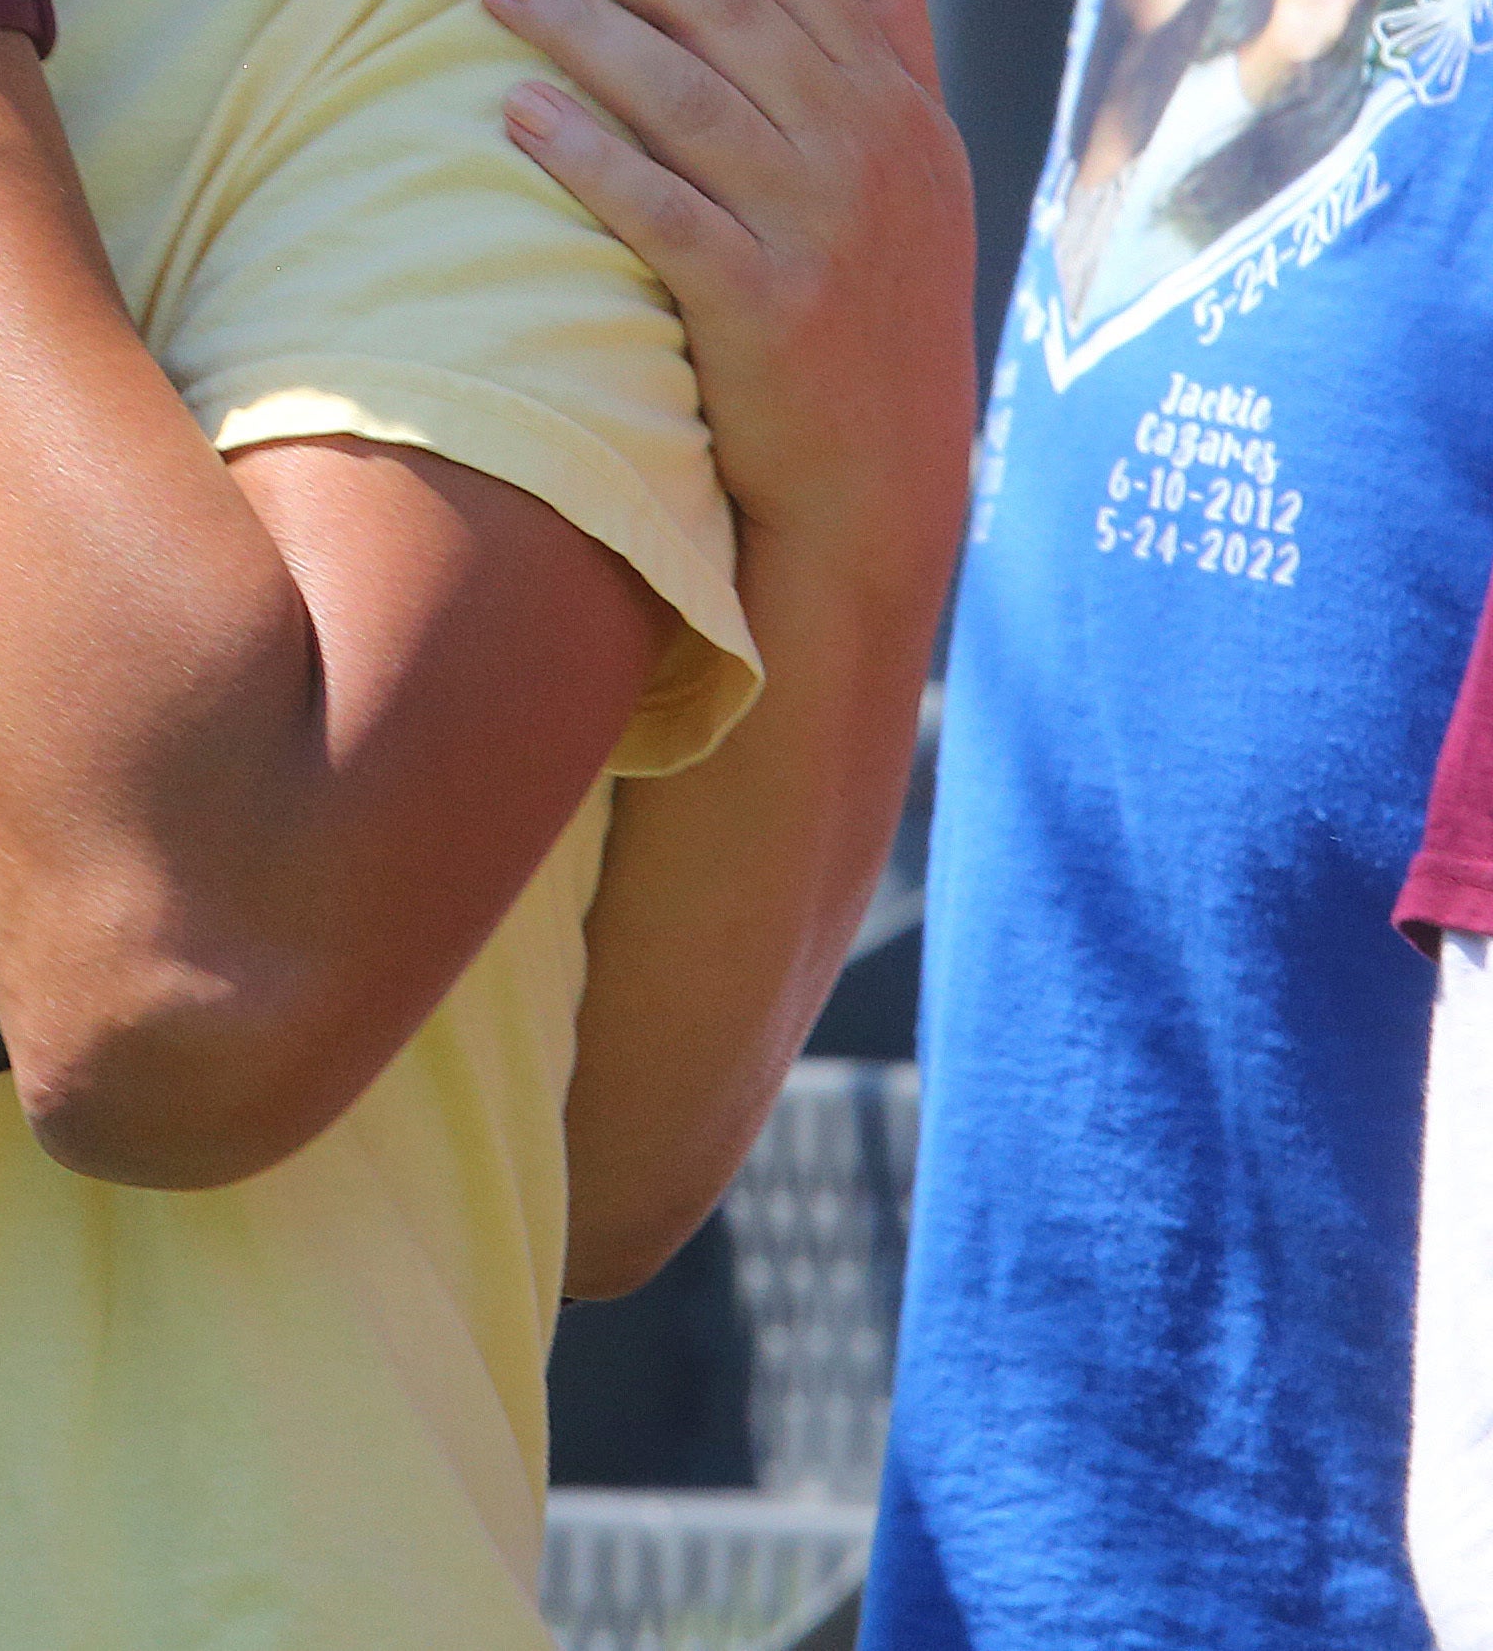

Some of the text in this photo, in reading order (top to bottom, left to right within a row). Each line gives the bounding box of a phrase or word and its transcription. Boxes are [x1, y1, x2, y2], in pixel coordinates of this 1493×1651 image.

[1159, 371, 1273, 433] Jackie
[1107, 457, 1304, 534] 6-10-2012
[1096, 505, 1301, 587] 5-24-2022
